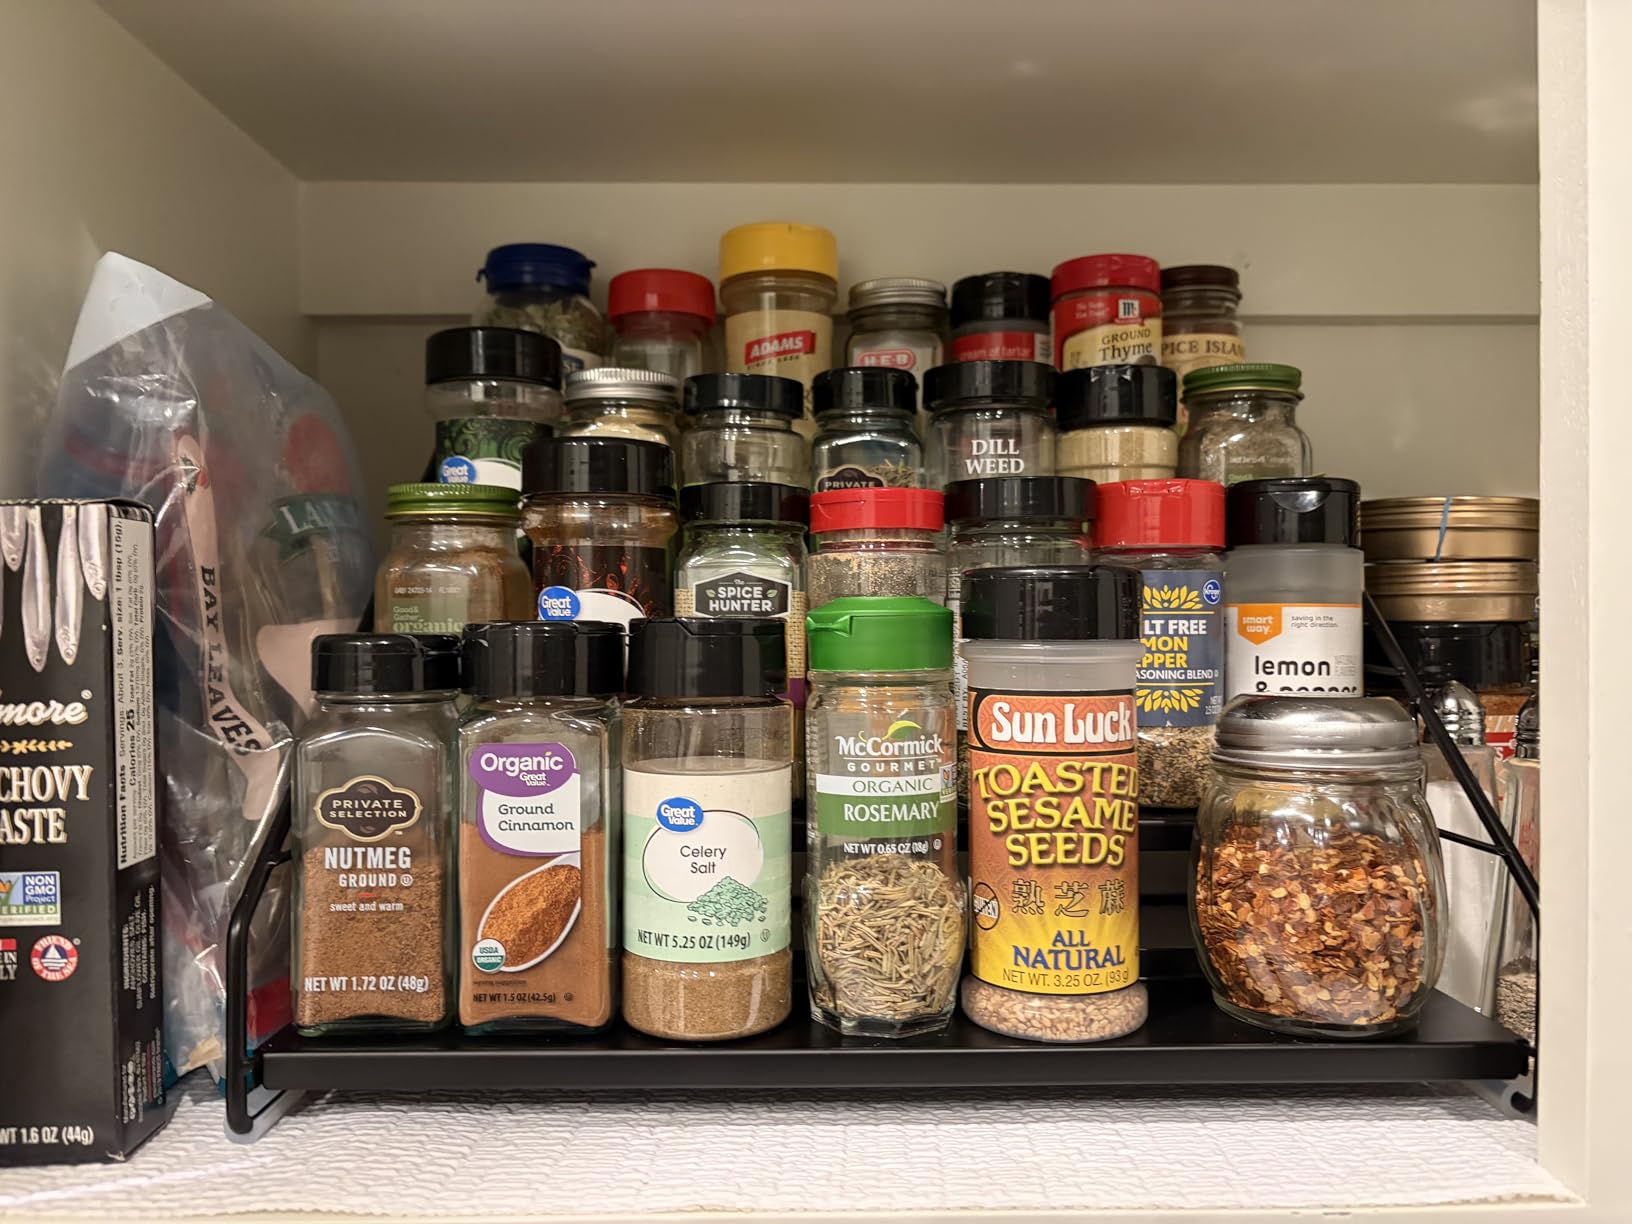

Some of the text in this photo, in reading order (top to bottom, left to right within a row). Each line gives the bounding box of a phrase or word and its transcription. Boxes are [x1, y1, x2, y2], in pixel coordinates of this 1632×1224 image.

[1102, 329, 1151, 345] GROUND
[750, 337, 804, 358] ADAMS
[1099, 343, 1153, 361] Thyme
[971, 439, 1019, 456] DILL
[442, 464, 469, 477] Great
[965, 458, 1024, 474] WEED
[825, 481, 875, 489] PRIVATE
[115, 557, 123, 582] tbsp
[200, 566, 220, 633] BAY
[718, 586, 763, 599] SPICE
[541, 595, 572, 609] Great
[709, 599, 773, 612] HUNTER
[547, 608, 572, 617] Value
[1242, 615, 1273, 625] smart
[393, 618, 465, 633] organic
[1168, 619, 1208, 635] FREE
[1255, 655, 1331, 676] lemon
[1186, 669, 1214, 680] BLEND
[116, 673, 124, 704] About
[207, 643, 262, 757] LEAVES
[126, 709, 135, 731] 25
[991, 700, 1133, 744] Sun Luck
[834, 733, 945, 757] McCormick
[480, 752, 564, 777] Organic
[847, 760, 936, 773] GOURMET
[118, 764, 126, 800] Facts
[519, 772, 547, 781] Great
[852, 777, 933, 793] ORGANIC
[332, 799, 403, 809] PRIVATE
[498, 803, 555, 815] Ground
[660, 804, 696, 819] Great
[843, 800, 940, 822] ROSEMARY
[329, 810, 407, 818] SELECTION
[668, 816, 696, 826] Value
[986, 796, 1137, 833] SESAME
[498, 819, 575, 832] Cinnamon
[119, 805, 128, 864] Nutrition
[679, 845, 727, 860] Celery
[843, 842, 860, 854] NET
[860, 843, 876, 854] WT
[877, 843, 897, 854] 0.65
[897, 843, 912, 854] OZ
[1005, 832, 1126, 867] SEEDS
[324, 847, 411, 869] NUTMEG
[690, 861, 716, 874] Salt
[24, 875, 55, 886] NON
[338, 874, 397, 887] GROUND
[24, 885, 56, 895] GMO
[25, 895, 56, 904] Project
[329, 901, 404, 912] sweet and warm
[637, 929, 751, 951] NET WT 5.25 OZ (149g)
[1051, 930, 1091, 947] ALL
[1013, 944, 1126, 971] NATURAL
[304, 975, 429, 993] NET WT 1.72 OZ (48g)
[1002, 968, 1026, 984] NET
[1028, 972, 1050, 987] WT.
[1053, 974, 1080, 988] 3.25
[1083, 973, 1103, 987] OZ.
[473, 992, 557, 1003] NET WT 1.5 OZ (42.5g)
[20, 1126, 39, 1145] 1.6
[41, 1126, 60, 1144] OZ
[61, 1125, 95, 1146] (44g)
